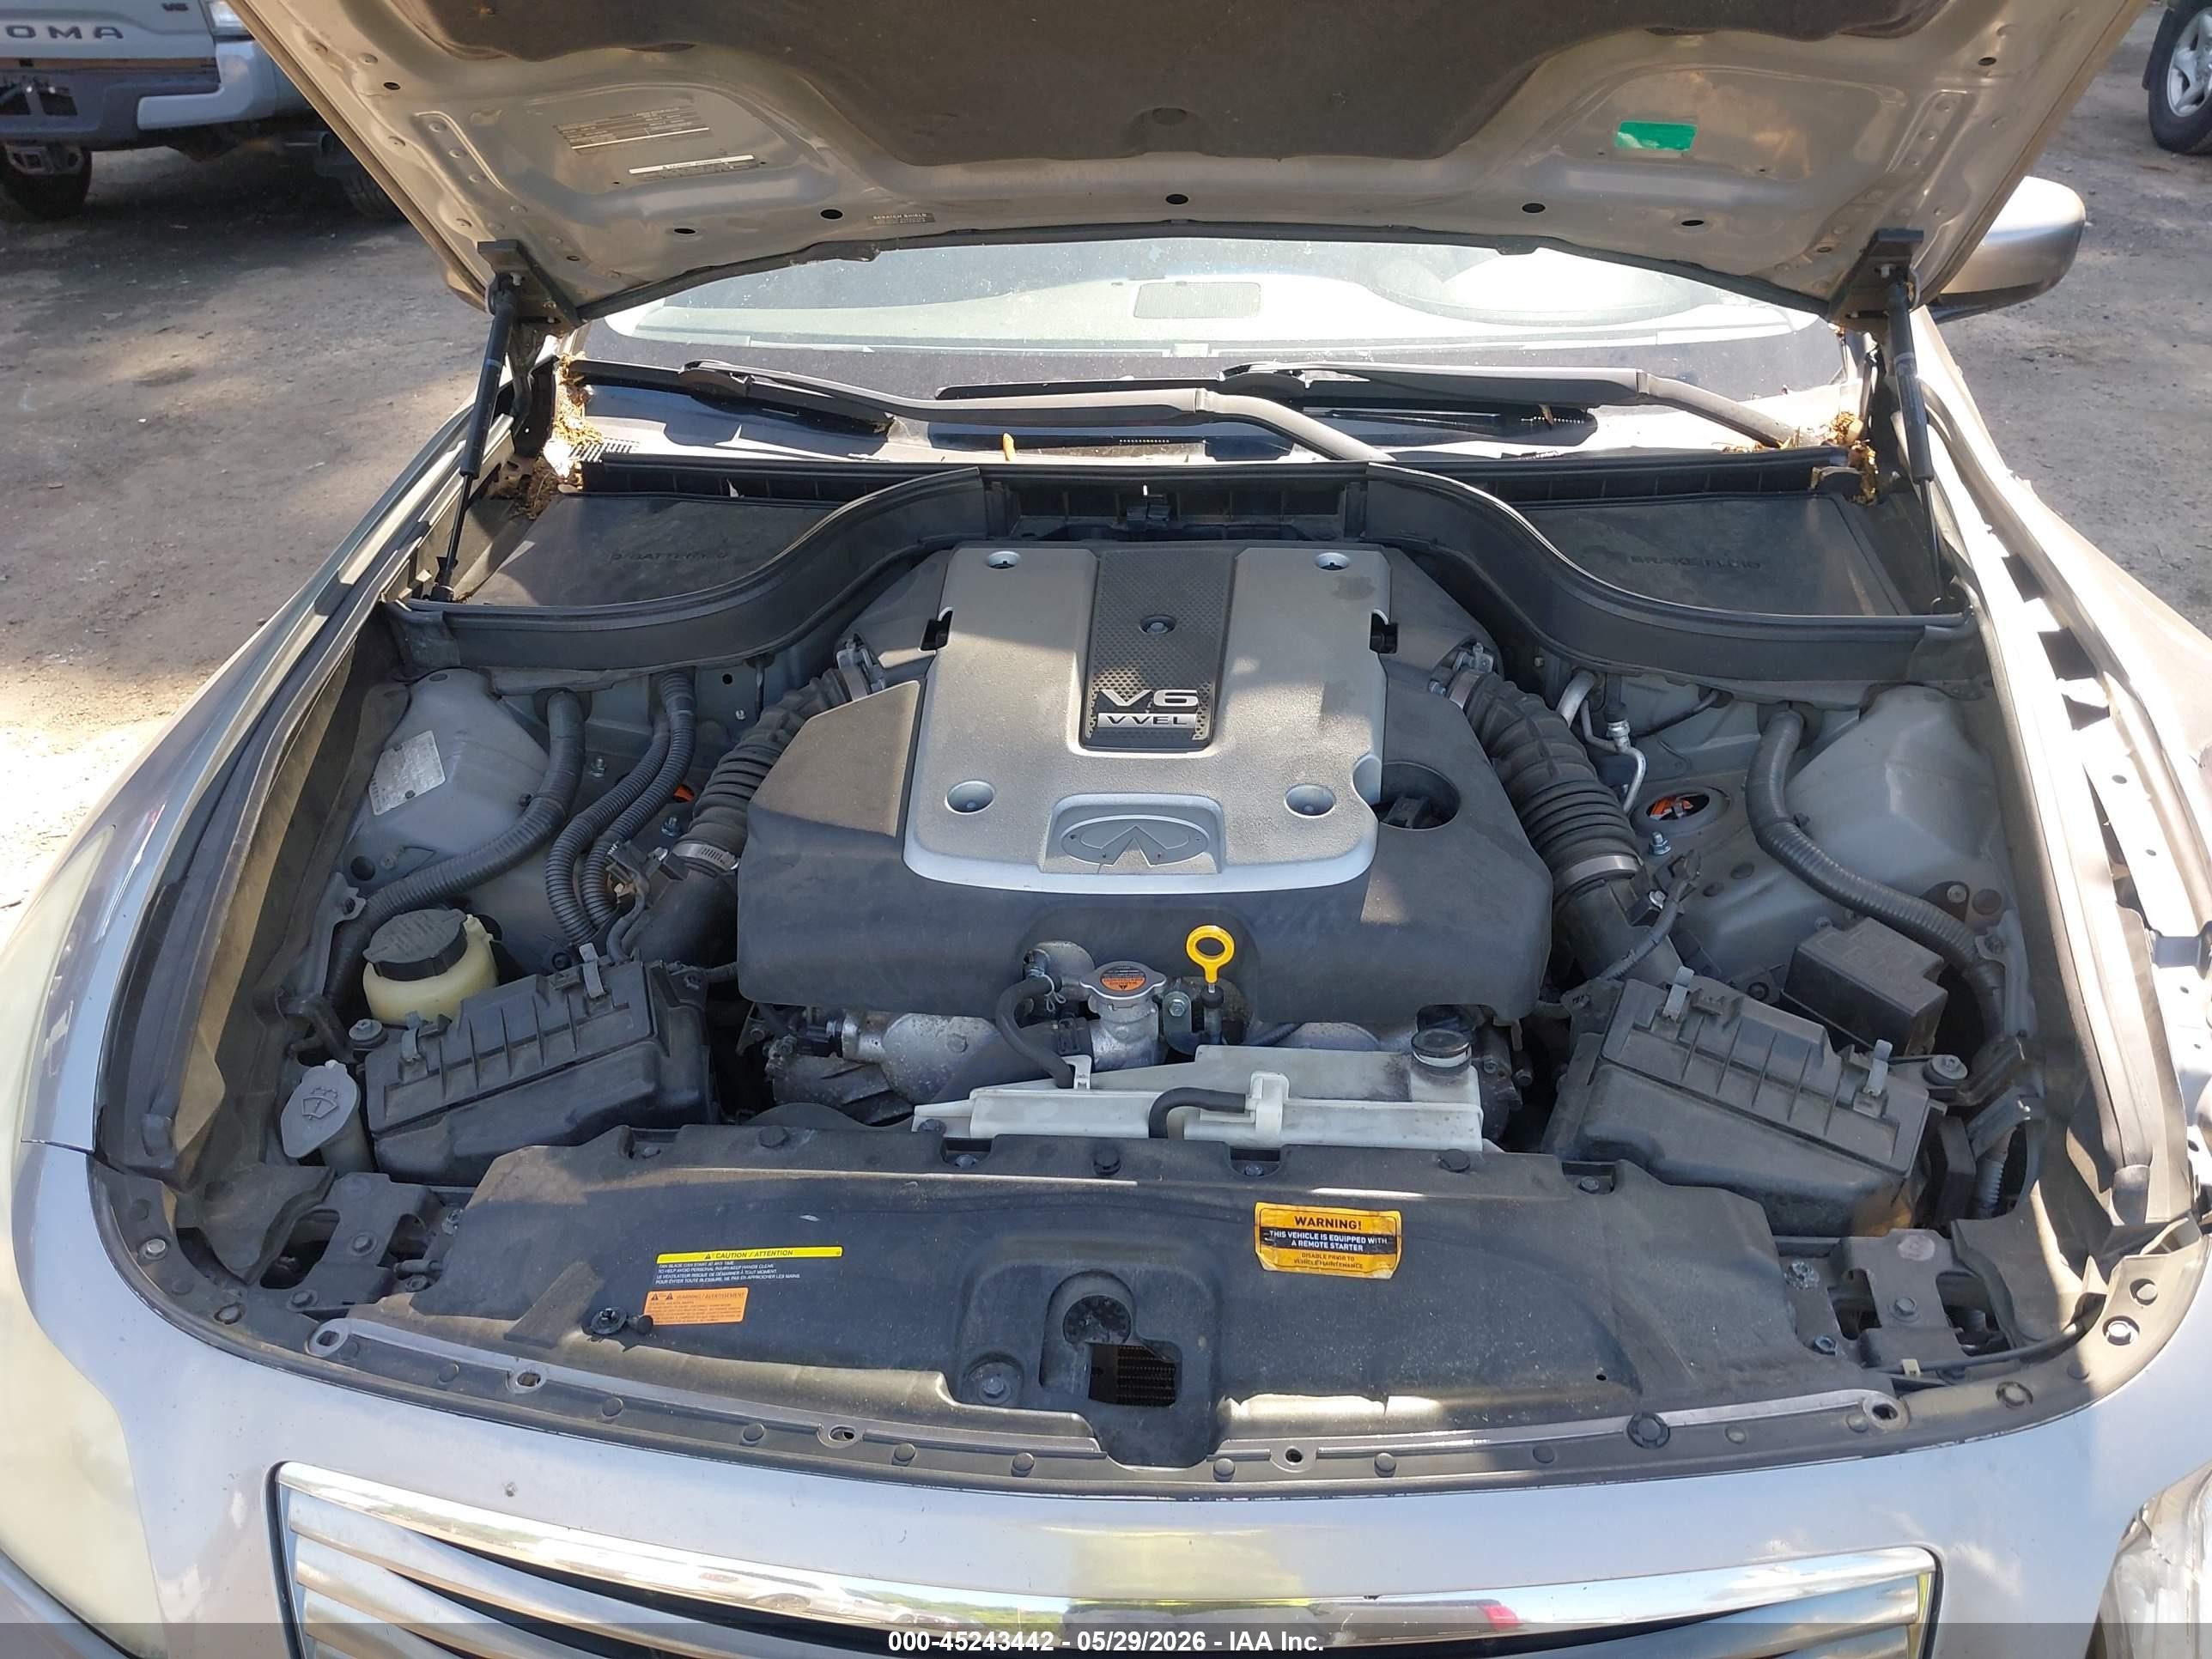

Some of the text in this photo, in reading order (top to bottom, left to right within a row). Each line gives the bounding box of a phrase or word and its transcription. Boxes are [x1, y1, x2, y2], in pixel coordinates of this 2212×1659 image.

[1100, 689, 1199, 707] V6
[1106, 715, 1188, 726] VVEL
[1294, 1215, 1362, 1231] WARNING!
[1269, 1230, 1286, 1238] THIS
[1288, 1231, 1319, 1240] VEHICLE
[1329, 1234, 1366, 1244] EQUIPPED
[1298, 1240, 1328, 1249] REMOTE
[1330, 1243, 1364, 1251] STARTER
[1320, 1261, 1363, 1269] MAINTENANCE
